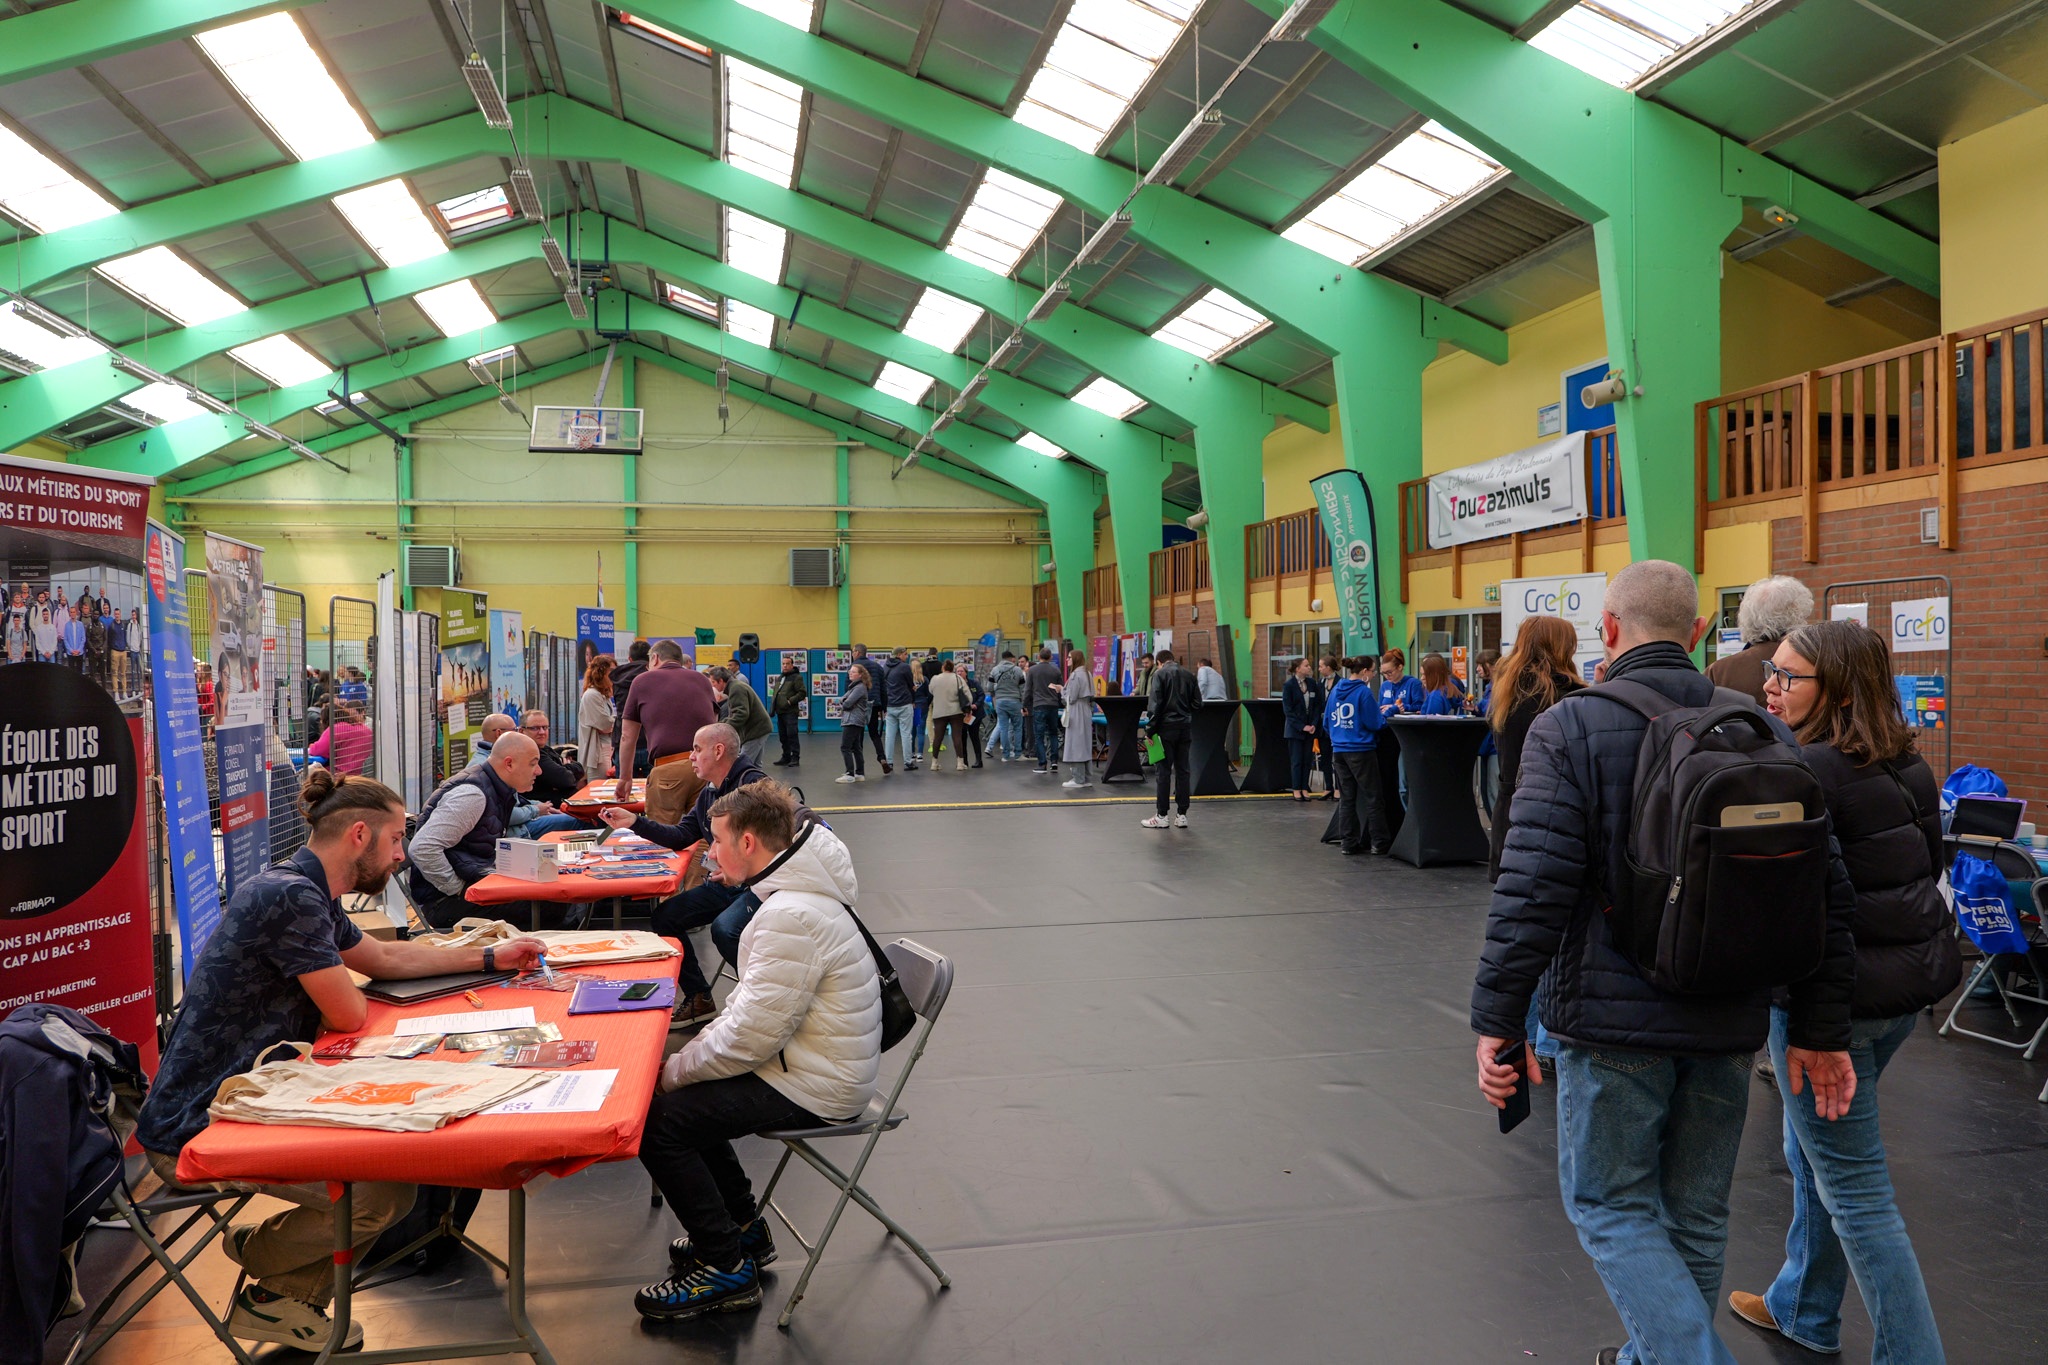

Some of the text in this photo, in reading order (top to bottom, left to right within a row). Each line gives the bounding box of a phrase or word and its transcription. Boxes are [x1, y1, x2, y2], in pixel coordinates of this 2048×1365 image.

[28, 476, 80, 500] MÉTIERS
[84, 486, 102, 502] DU
[106, 488, 141, 508] SPORT
[1450, 473, 1551, 520] Touzazimuts
[18, 504, 34, 522] ET
[38, 506, 57, 524] DU
[61, 508, 123, 530] TOURISME
[212, 558, 239, 576] AFTRAL
[1524, 581, 1580, 619] Crefo
[1895, 606, 1945, 642] Crefo
[2, 724, 99, 766] ÉCOLE DES
[2, 764, 117, 809] MÉTIERS DU
[2, 809, 67, 851] SPORT
[25, 932, 41, 946] EN
[44, 912, 131, 942] APPRENTISSAGE
[3, 939, 91, 969] CAP AU BAC +3
[34, 990, 45, 1002] ET
[47, 977, 96, 998] MARKETING
[76, 998, 121, 1016] ONSEILLER
[123, 990, 147, 1004] CLIENT
